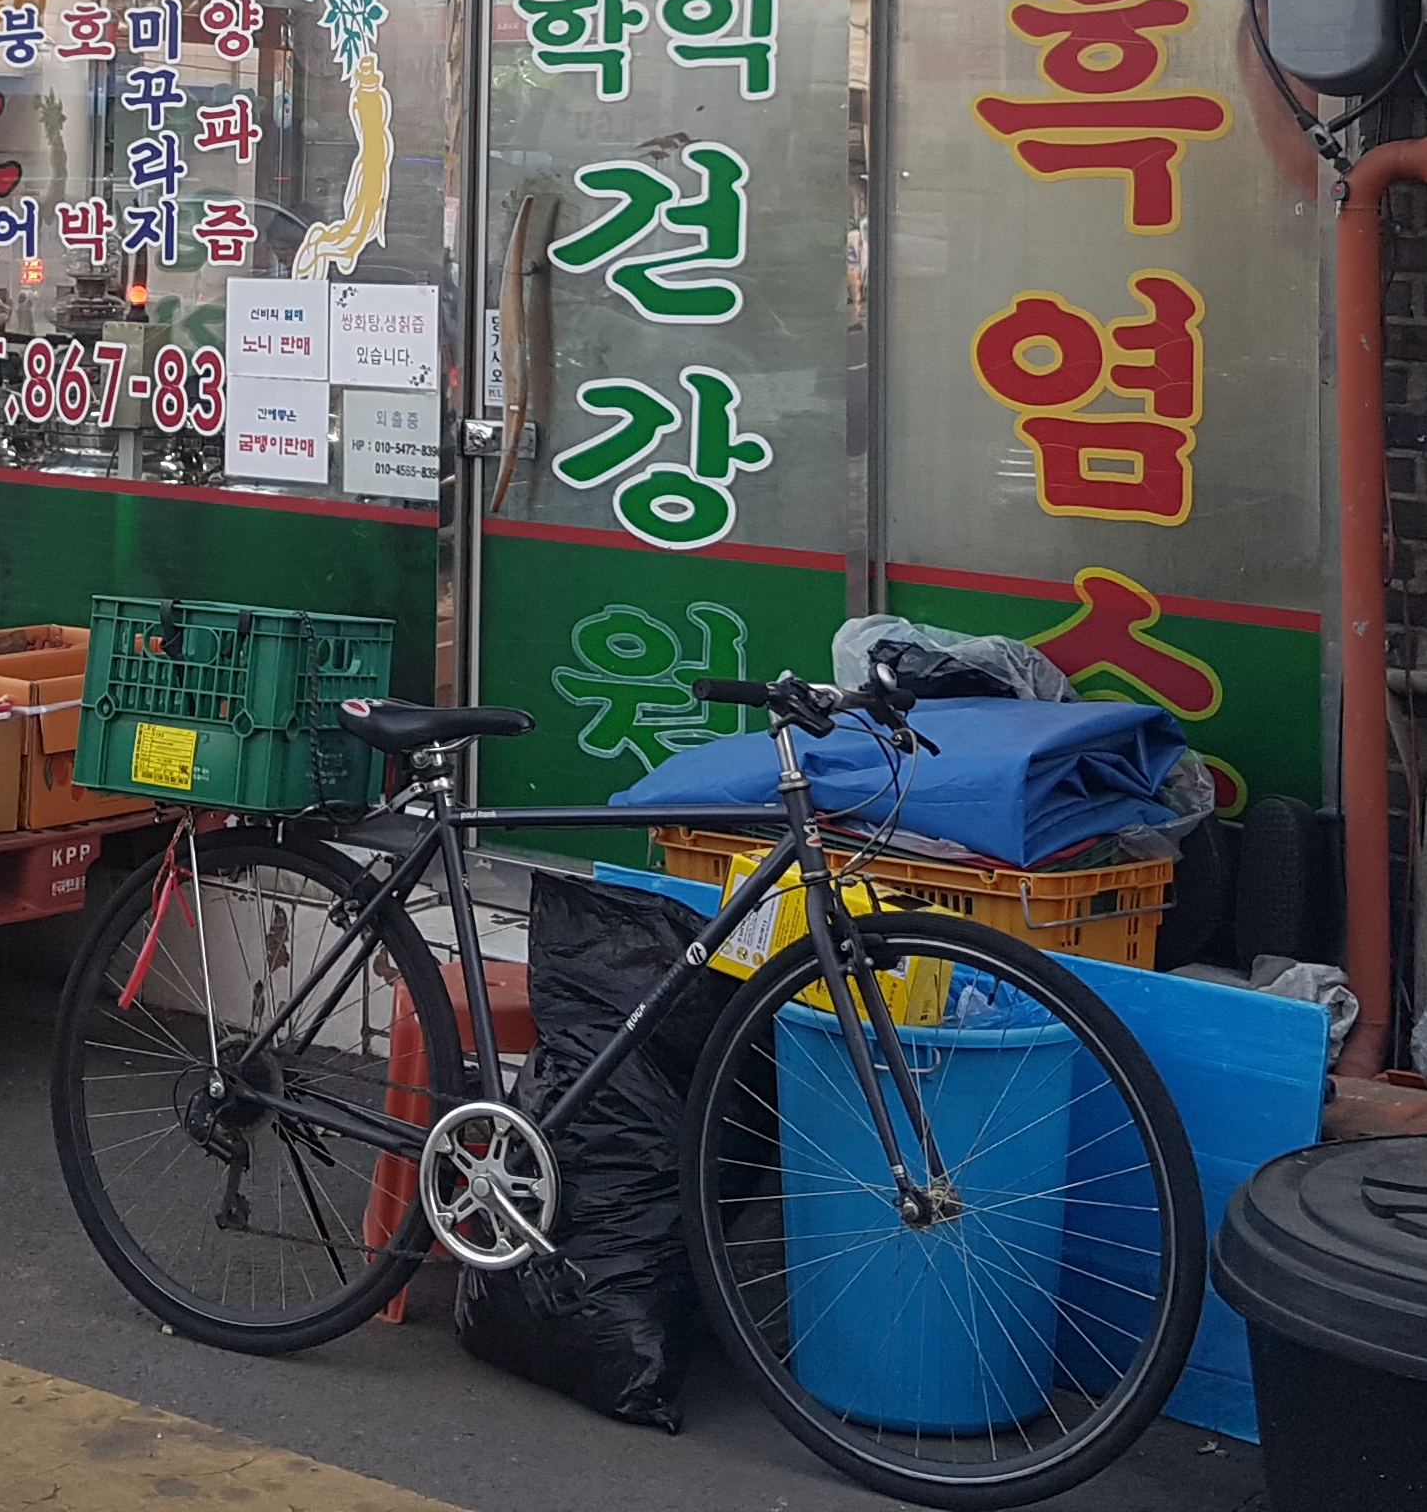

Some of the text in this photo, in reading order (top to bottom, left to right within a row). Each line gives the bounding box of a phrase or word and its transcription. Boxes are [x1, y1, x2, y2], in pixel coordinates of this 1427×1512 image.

[242, 335, 311, 356] 노니 판매
[357, 346, 414, 366] 있습니다.
[374, 440, 440, 457] 010-5472-839
[52, 844, 91, 867] KPP
